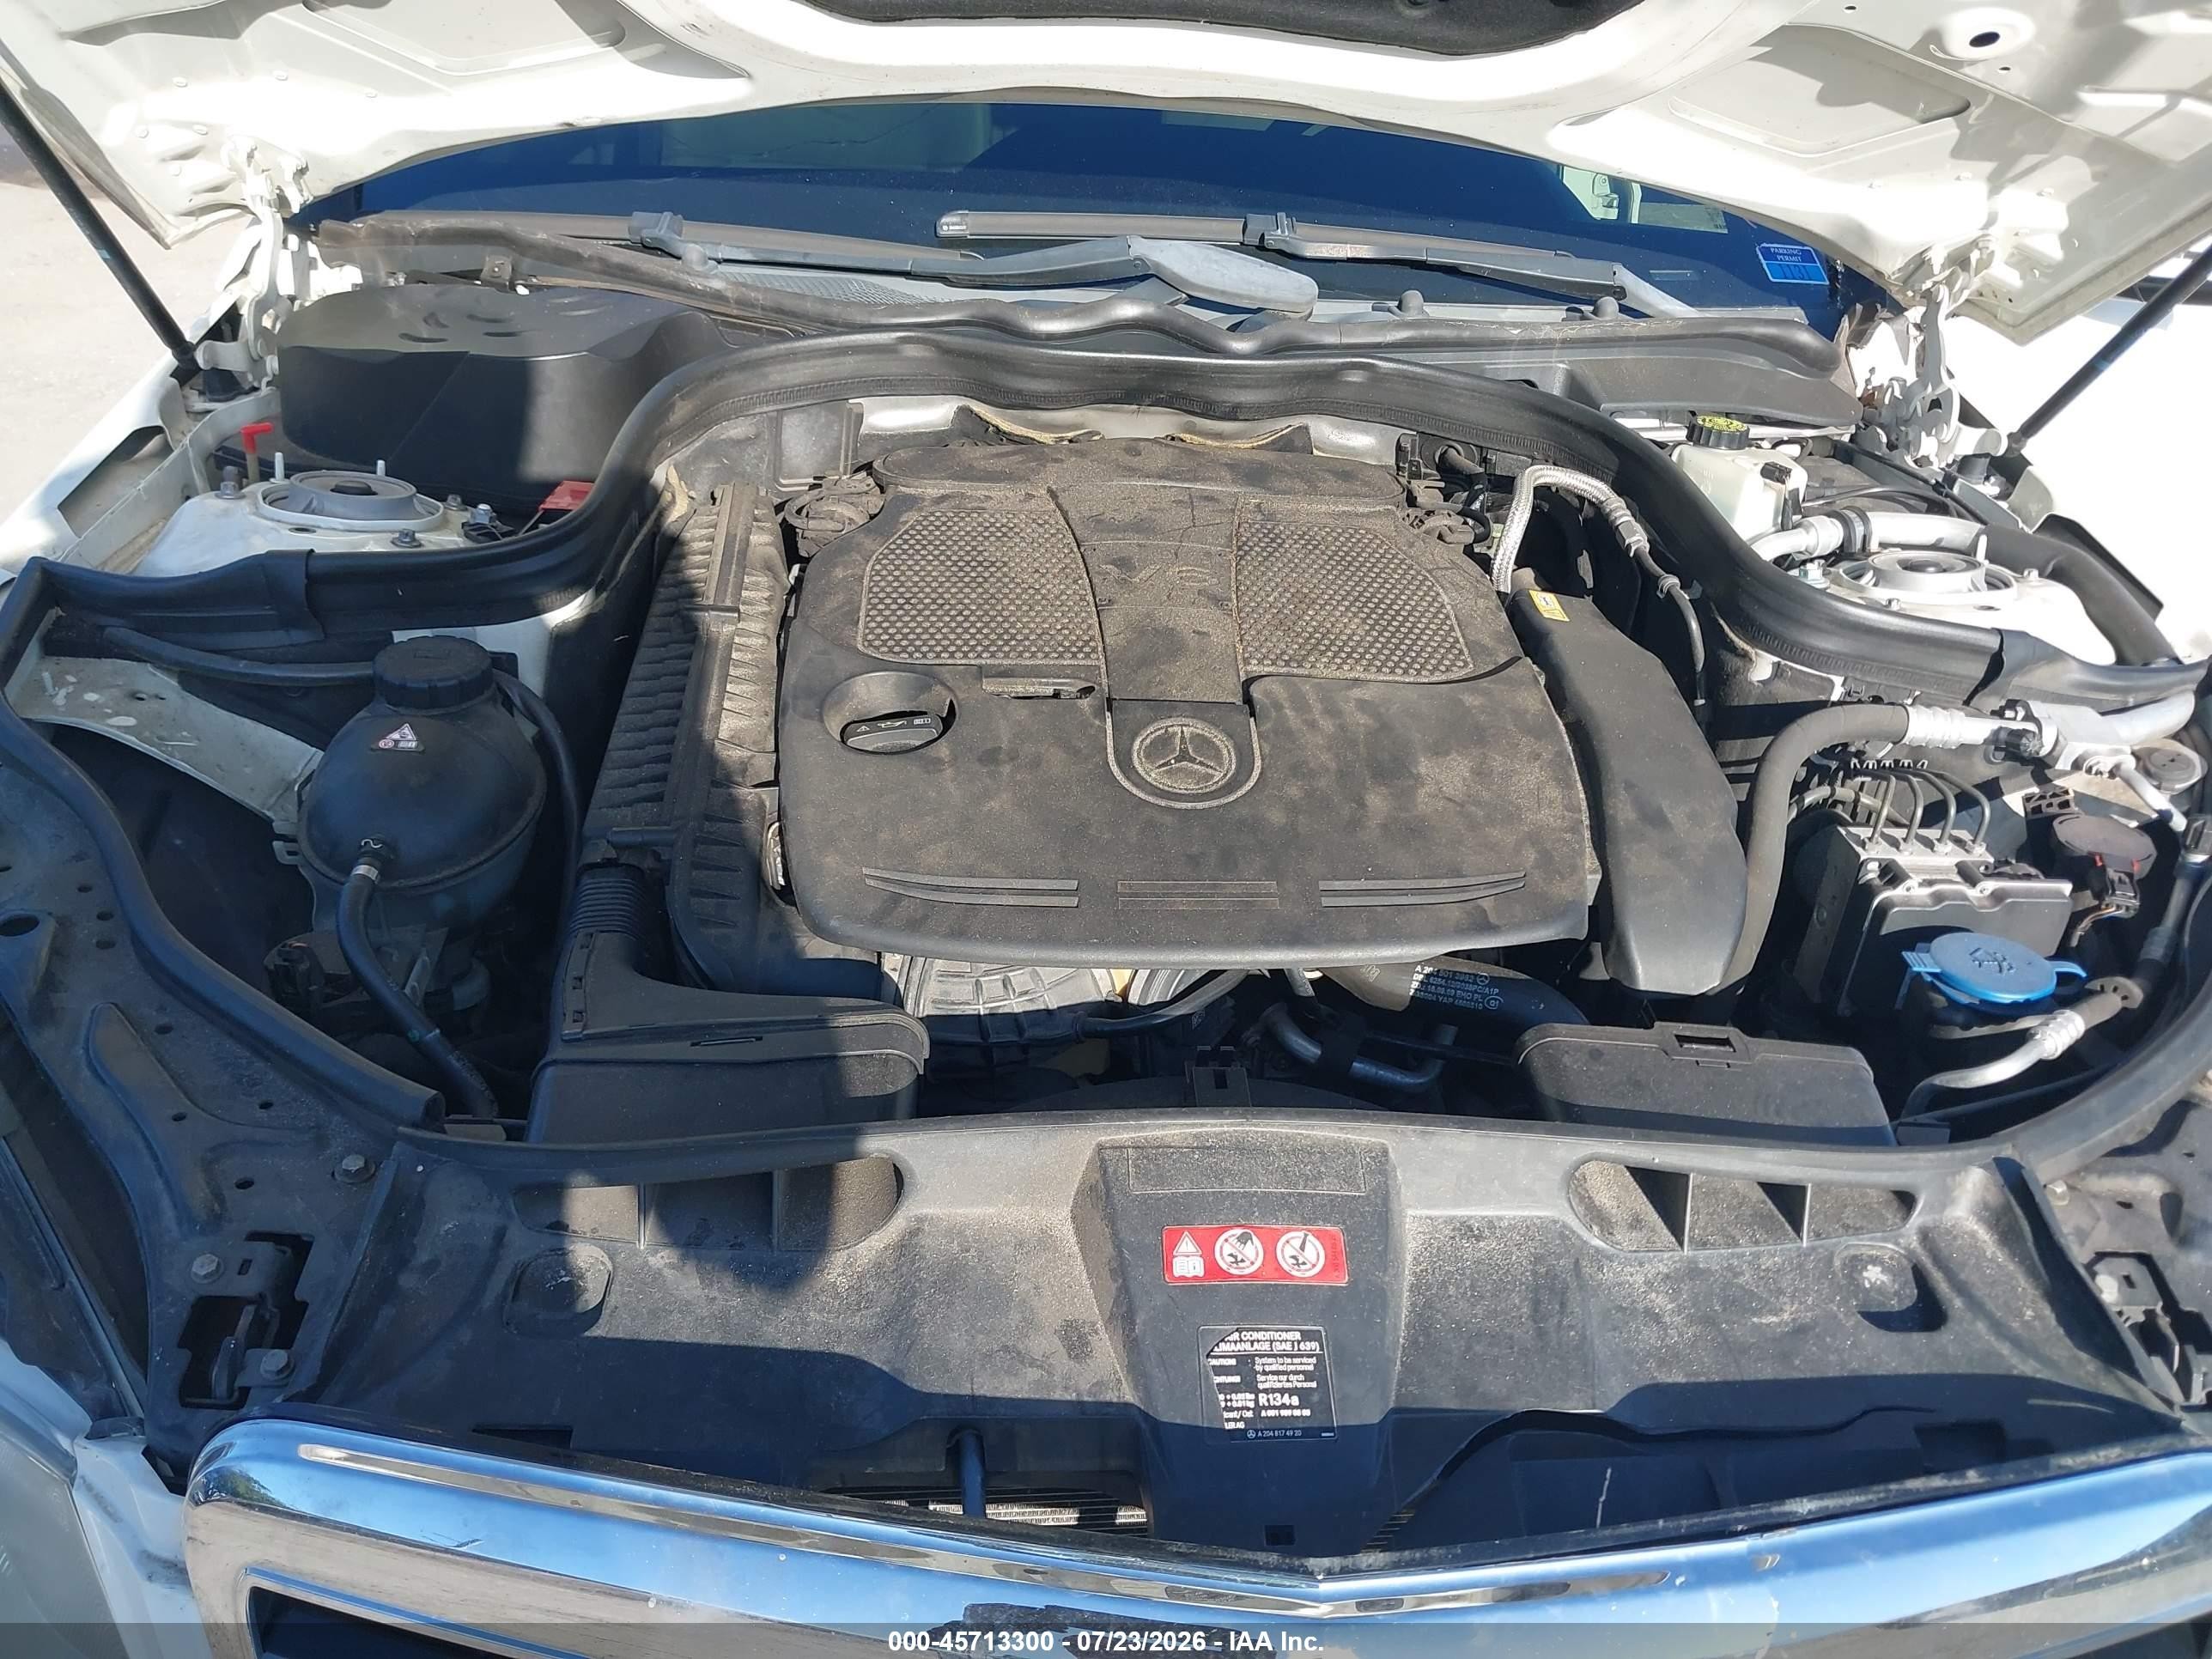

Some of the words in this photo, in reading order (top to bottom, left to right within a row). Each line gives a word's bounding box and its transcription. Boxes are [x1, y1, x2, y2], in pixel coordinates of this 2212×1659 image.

[1241, 1331, 1302, 1340] CONDITIONER
[1213, 1341, 1271, 1352] LIMAANLAGE
[1273, 1341, 1292, 1352] (SAE
[1299, 1341, 1320, 1352] 639)
[1255, 1357, 1276, 1365] System
[1258, 1393, 1299, 1407] R134a
